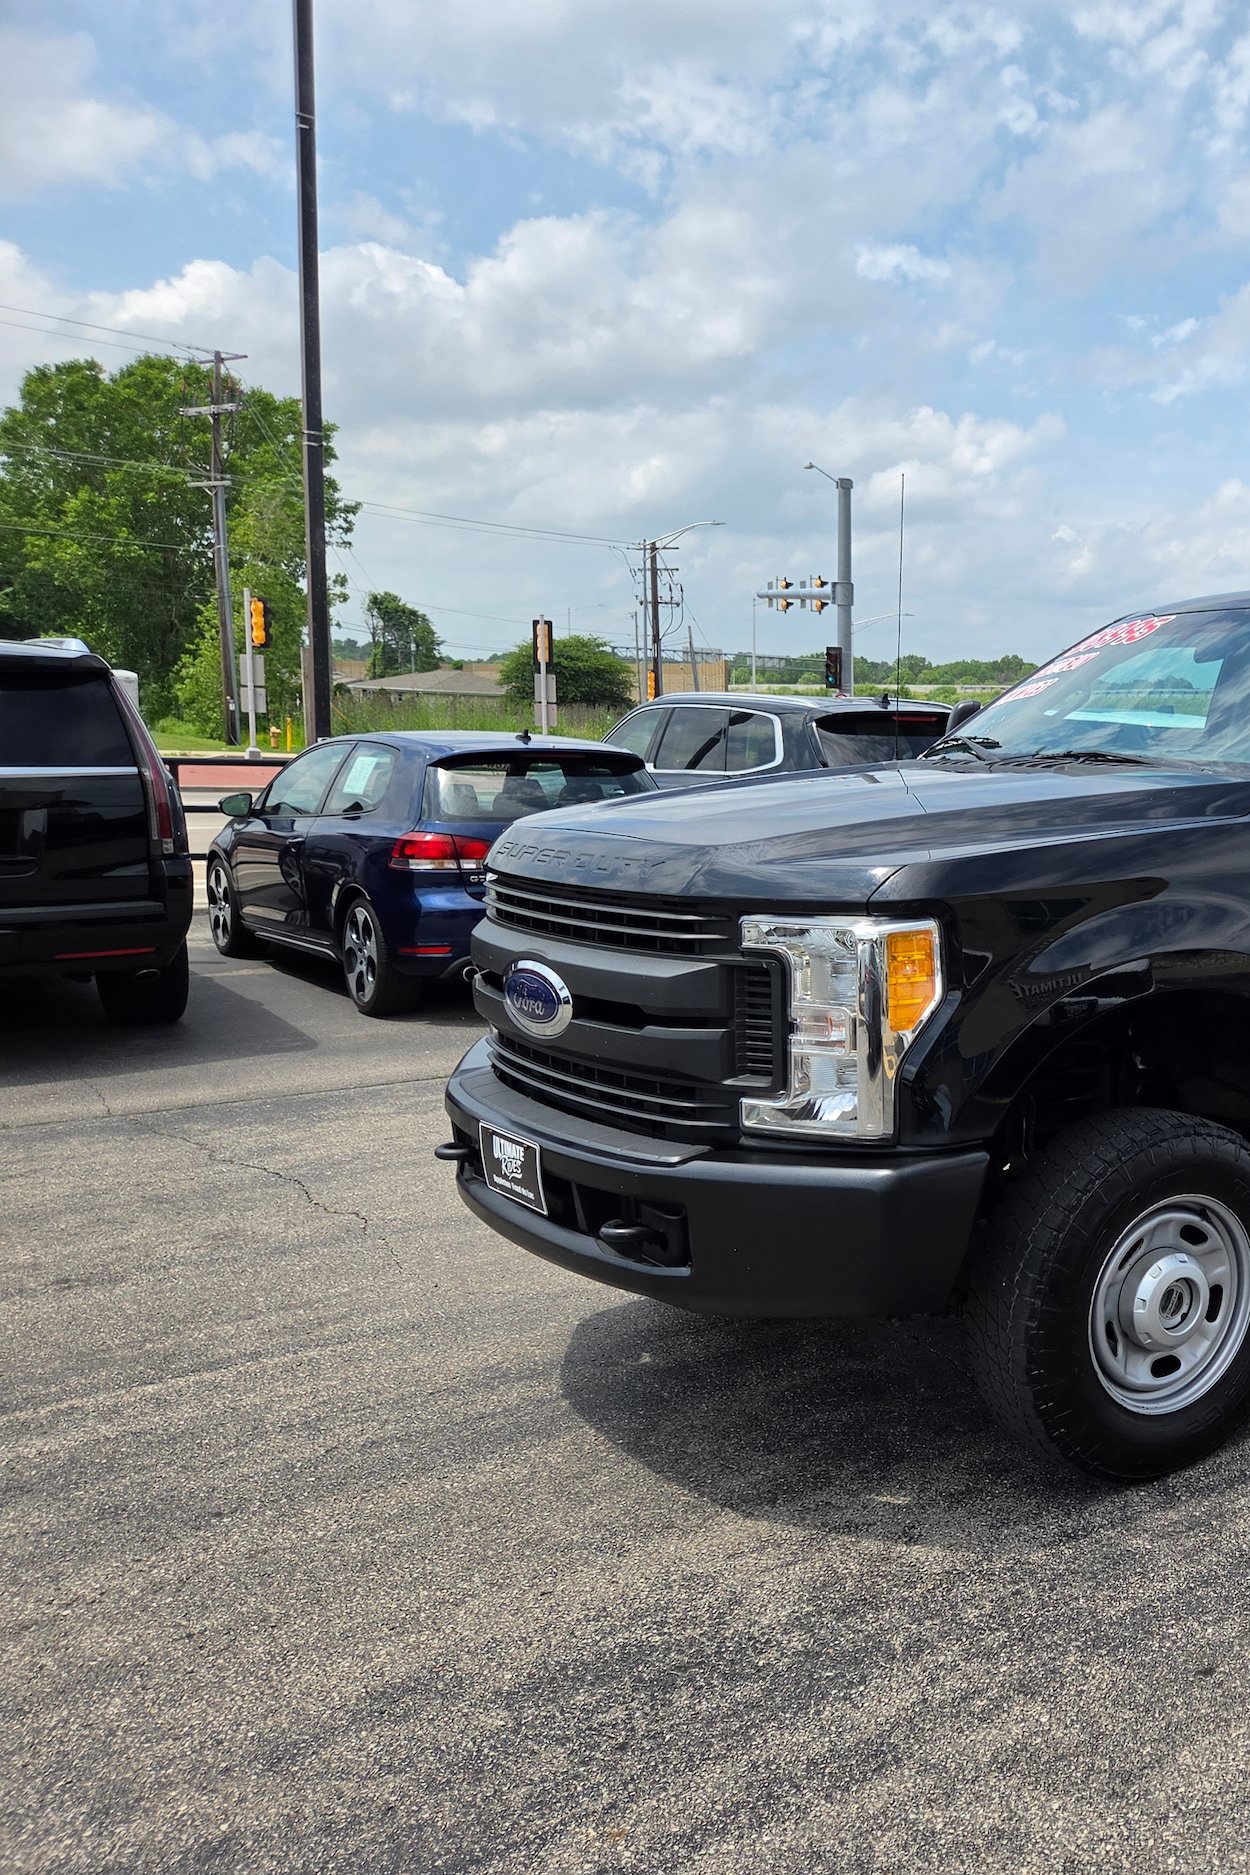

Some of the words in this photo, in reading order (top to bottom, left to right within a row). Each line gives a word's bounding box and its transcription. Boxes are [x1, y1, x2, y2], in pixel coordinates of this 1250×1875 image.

[496, 841, 572, 867] SUPER
[575, 853, 666, 878] DUTY
[492, 1134, 525, 1162] ULTIMATE
